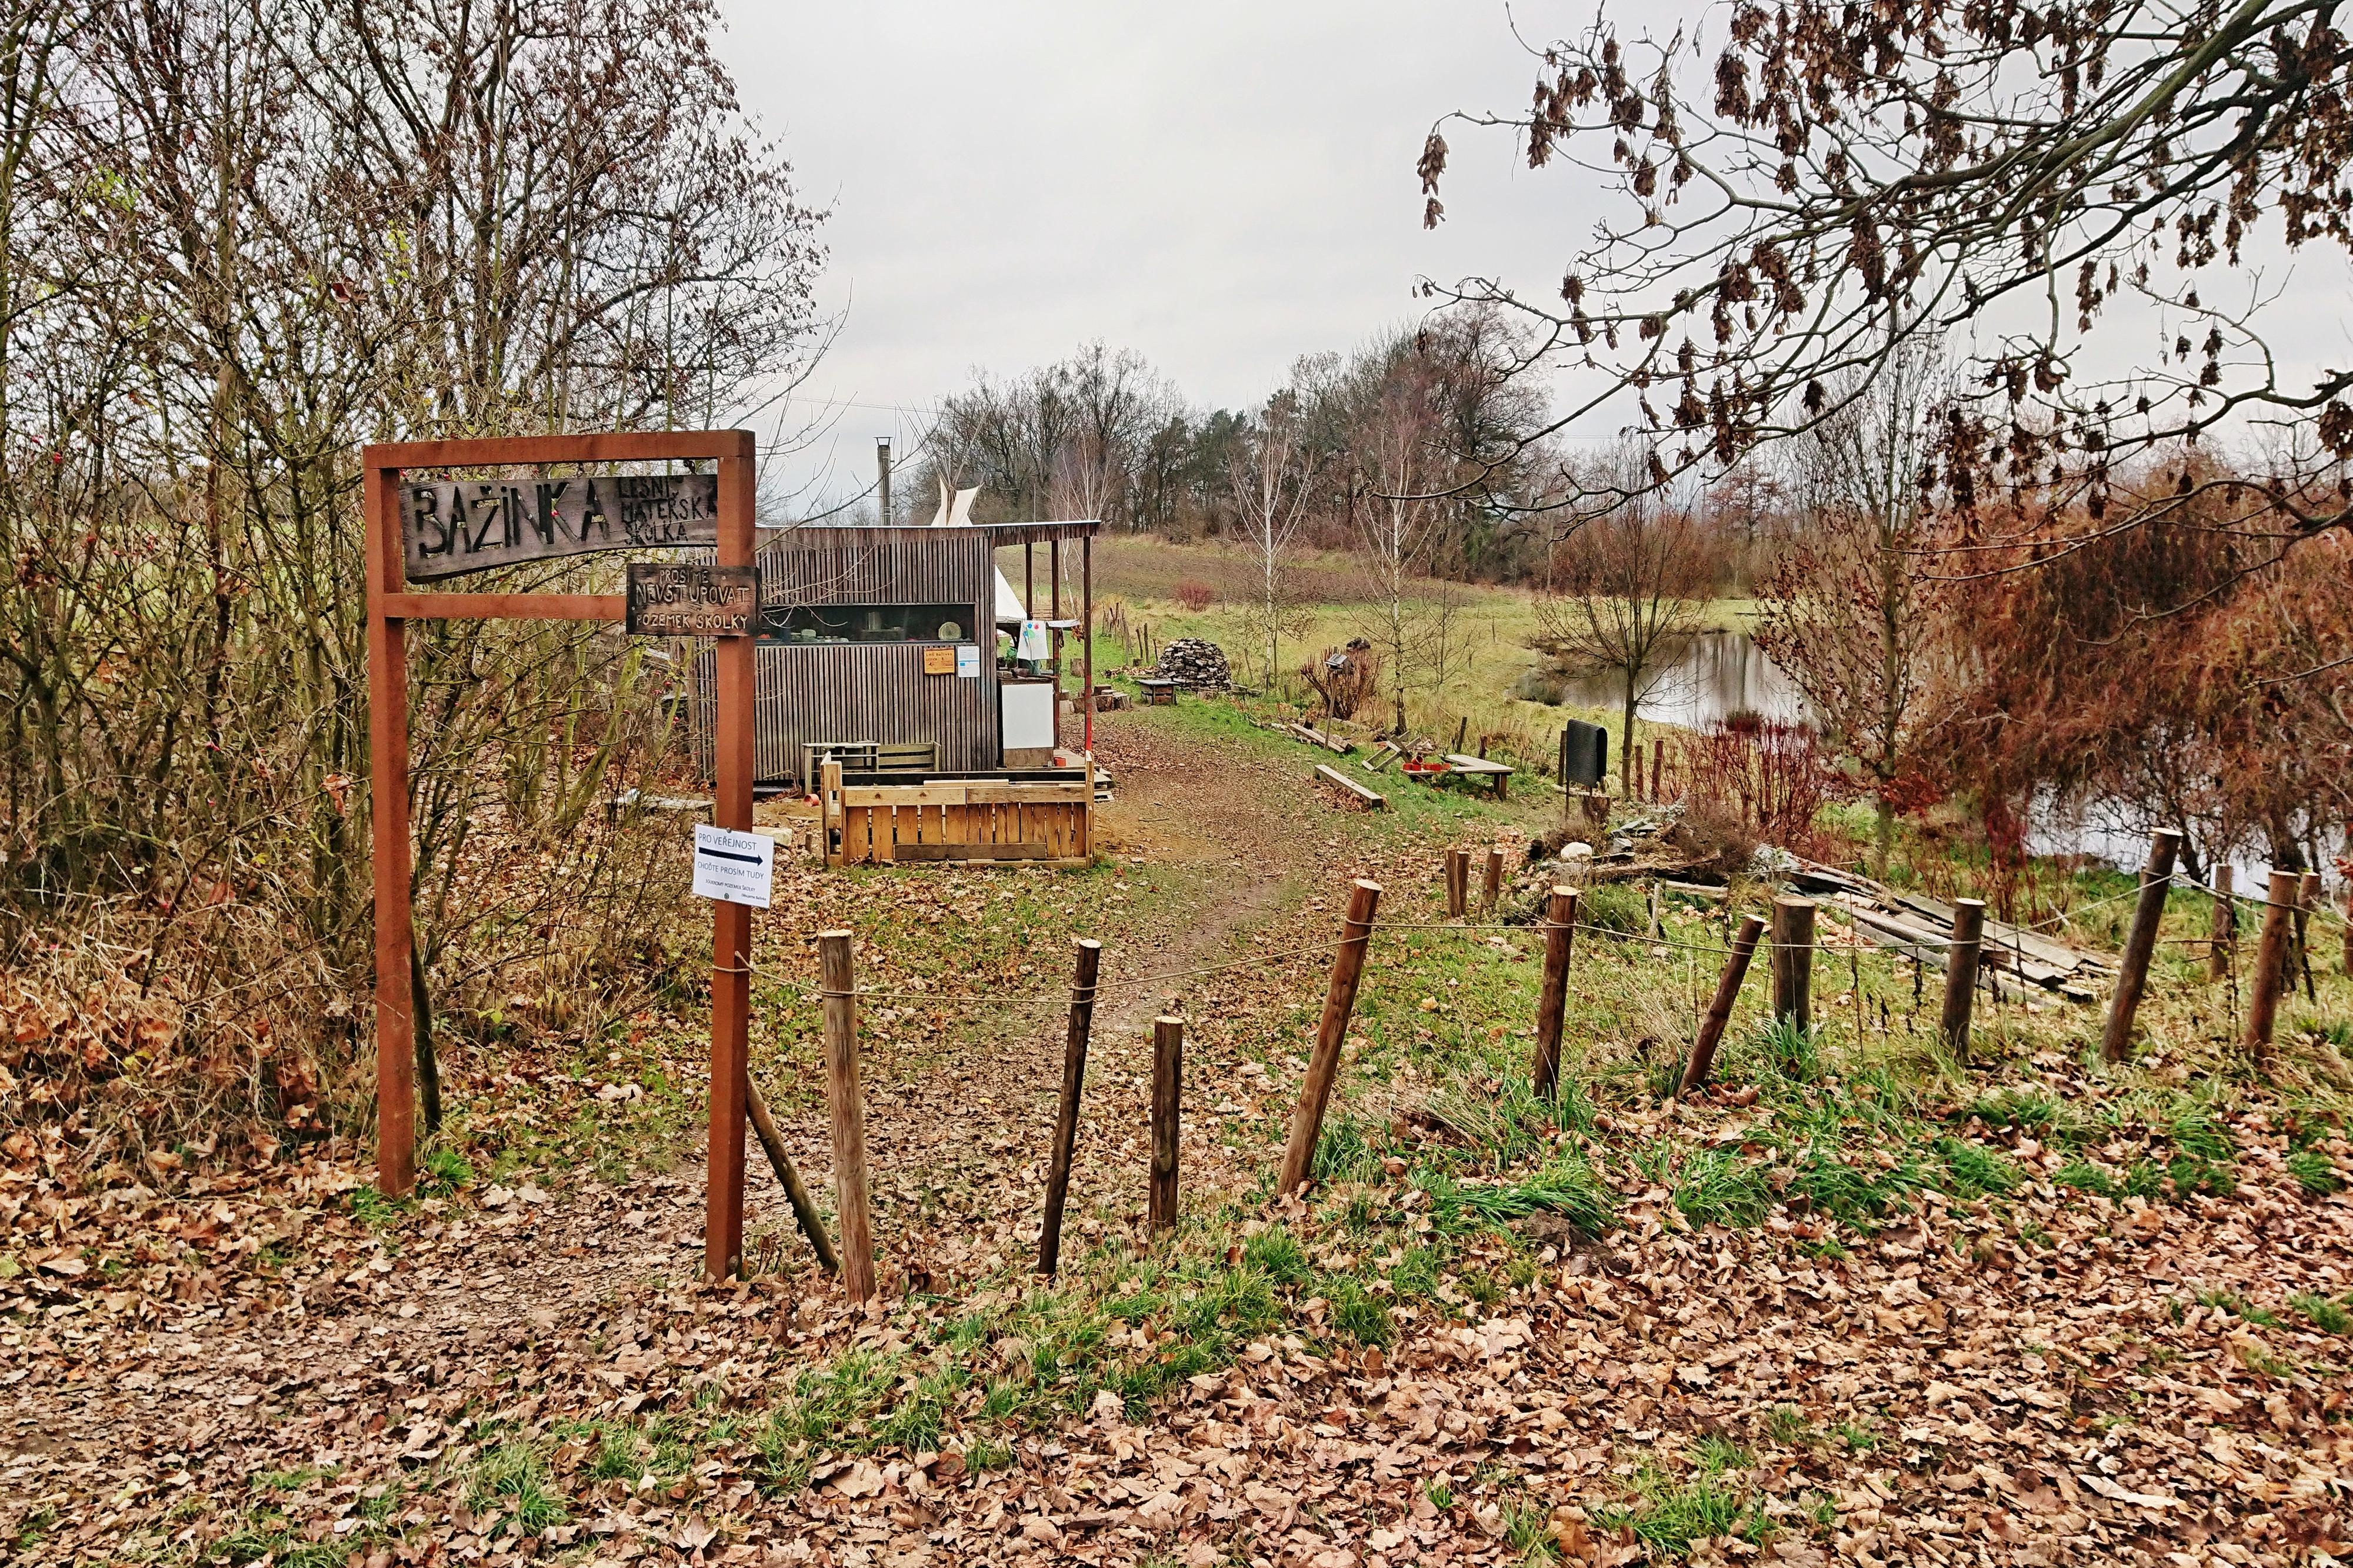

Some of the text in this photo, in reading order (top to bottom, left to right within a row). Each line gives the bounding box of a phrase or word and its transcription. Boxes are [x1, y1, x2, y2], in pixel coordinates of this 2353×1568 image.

[636, 614, 690, 629] POZEMEK
[699, 833, 757, 850] PRO VEŘEJNOST
[720, 866, 745, 877] PROSÍM
[746, 870, 764, 880] TUDY
